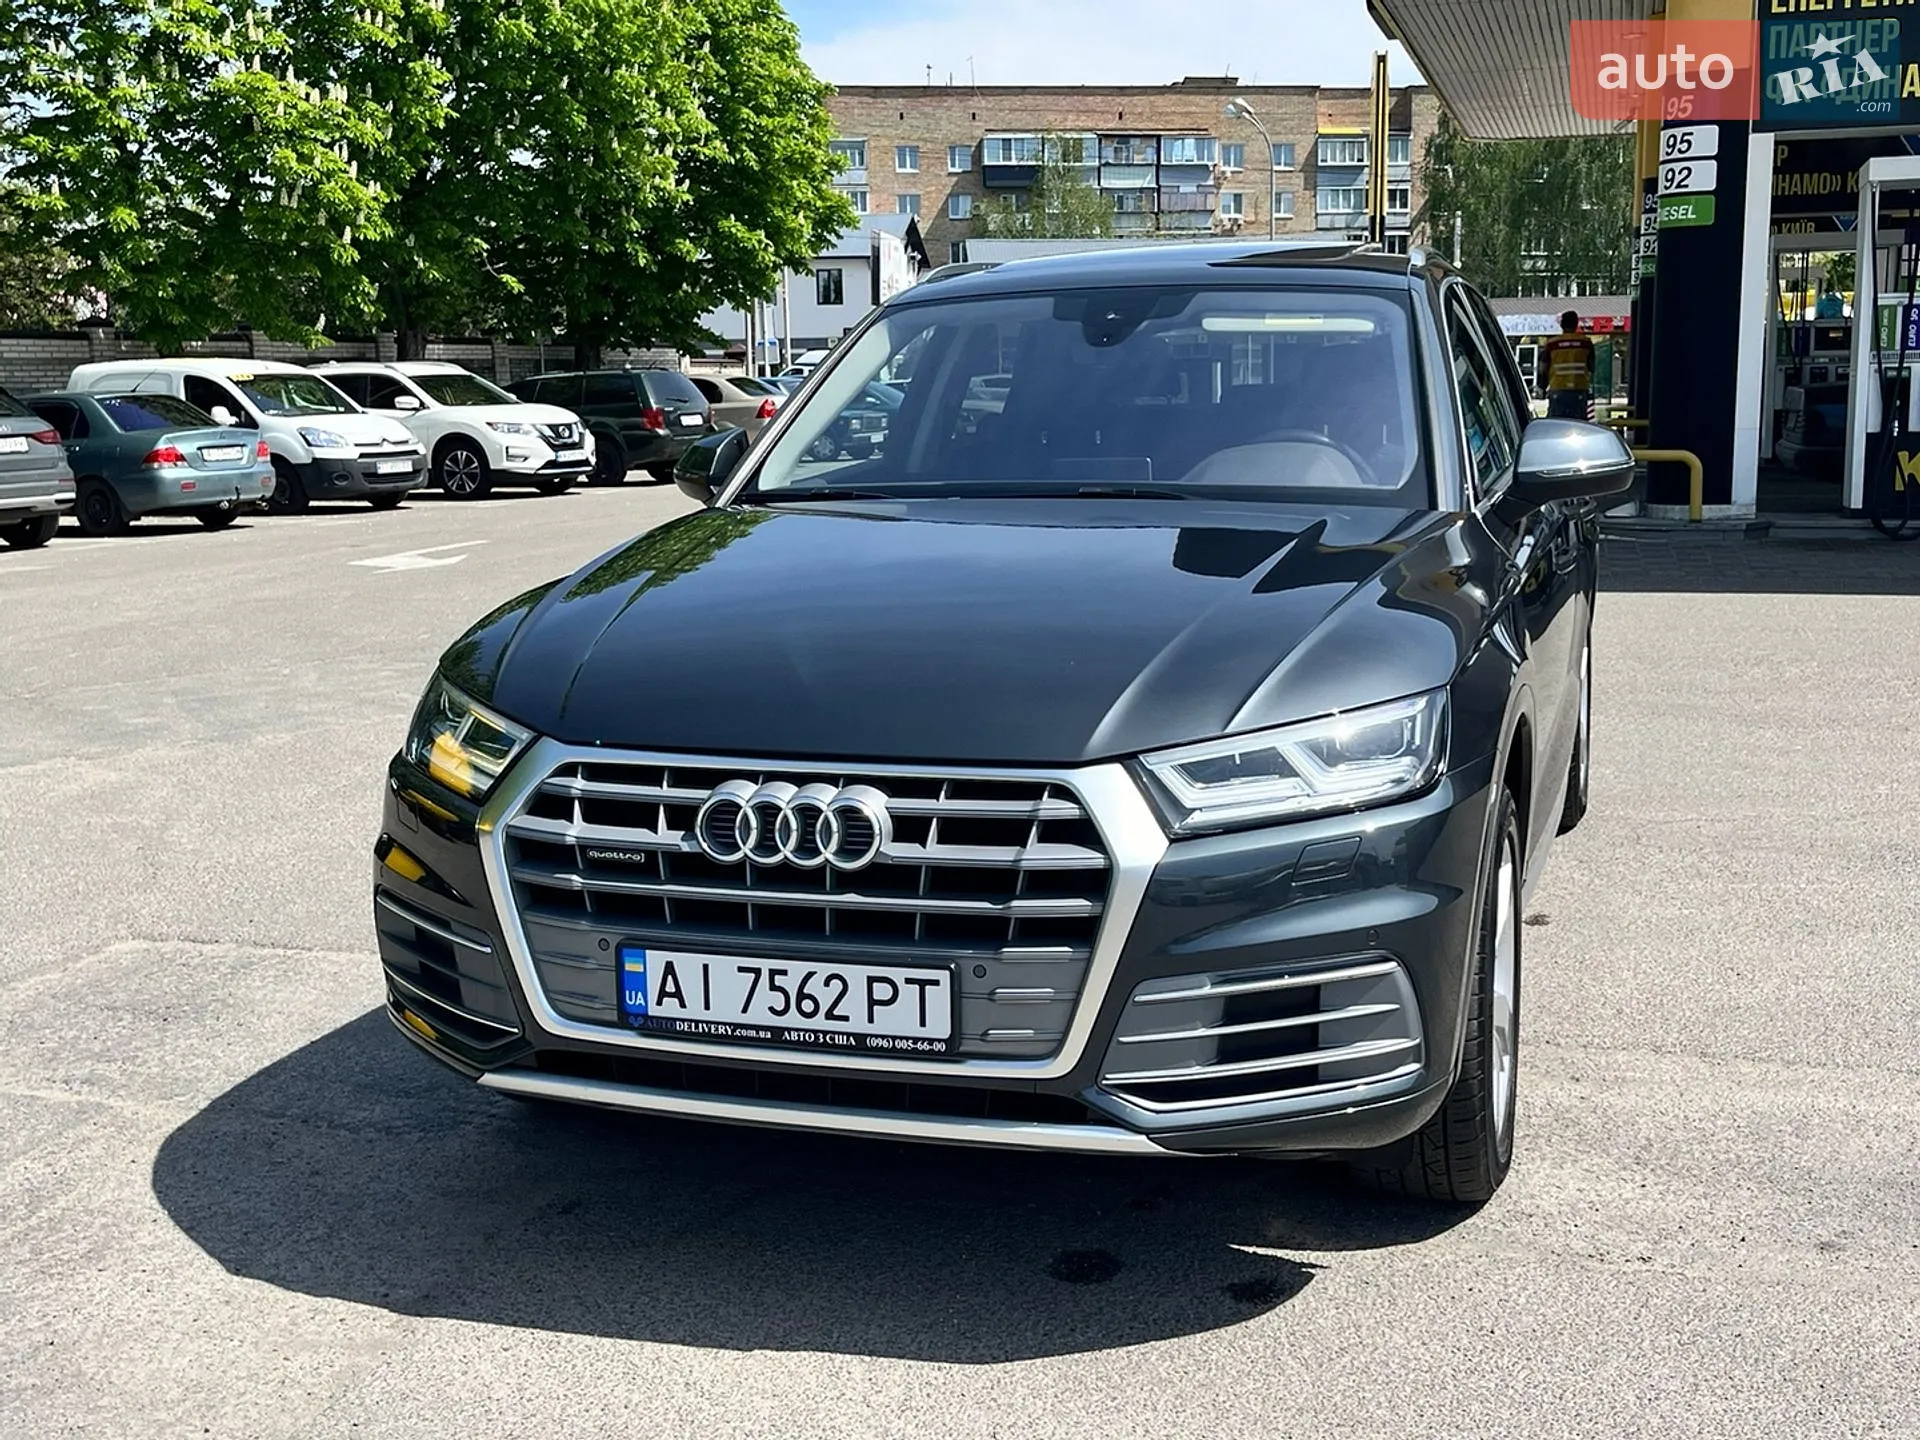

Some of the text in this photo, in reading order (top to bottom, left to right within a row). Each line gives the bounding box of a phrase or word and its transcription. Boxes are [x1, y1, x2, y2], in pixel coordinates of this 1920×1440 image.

[1769, 18, 1900, 60] ПАРТНЕР
[1666, 94, 1694, 120] 95
[1665, 132, 1694, 156] 95
[1664, 166, 1693, 190] 92
[589, 850, 641, 861] quattro
[625, 990, 646, 1006] UA
[655, 960, 941, 1028] AI 7562 PT
[866, 1036, 893, 1048] (096)
